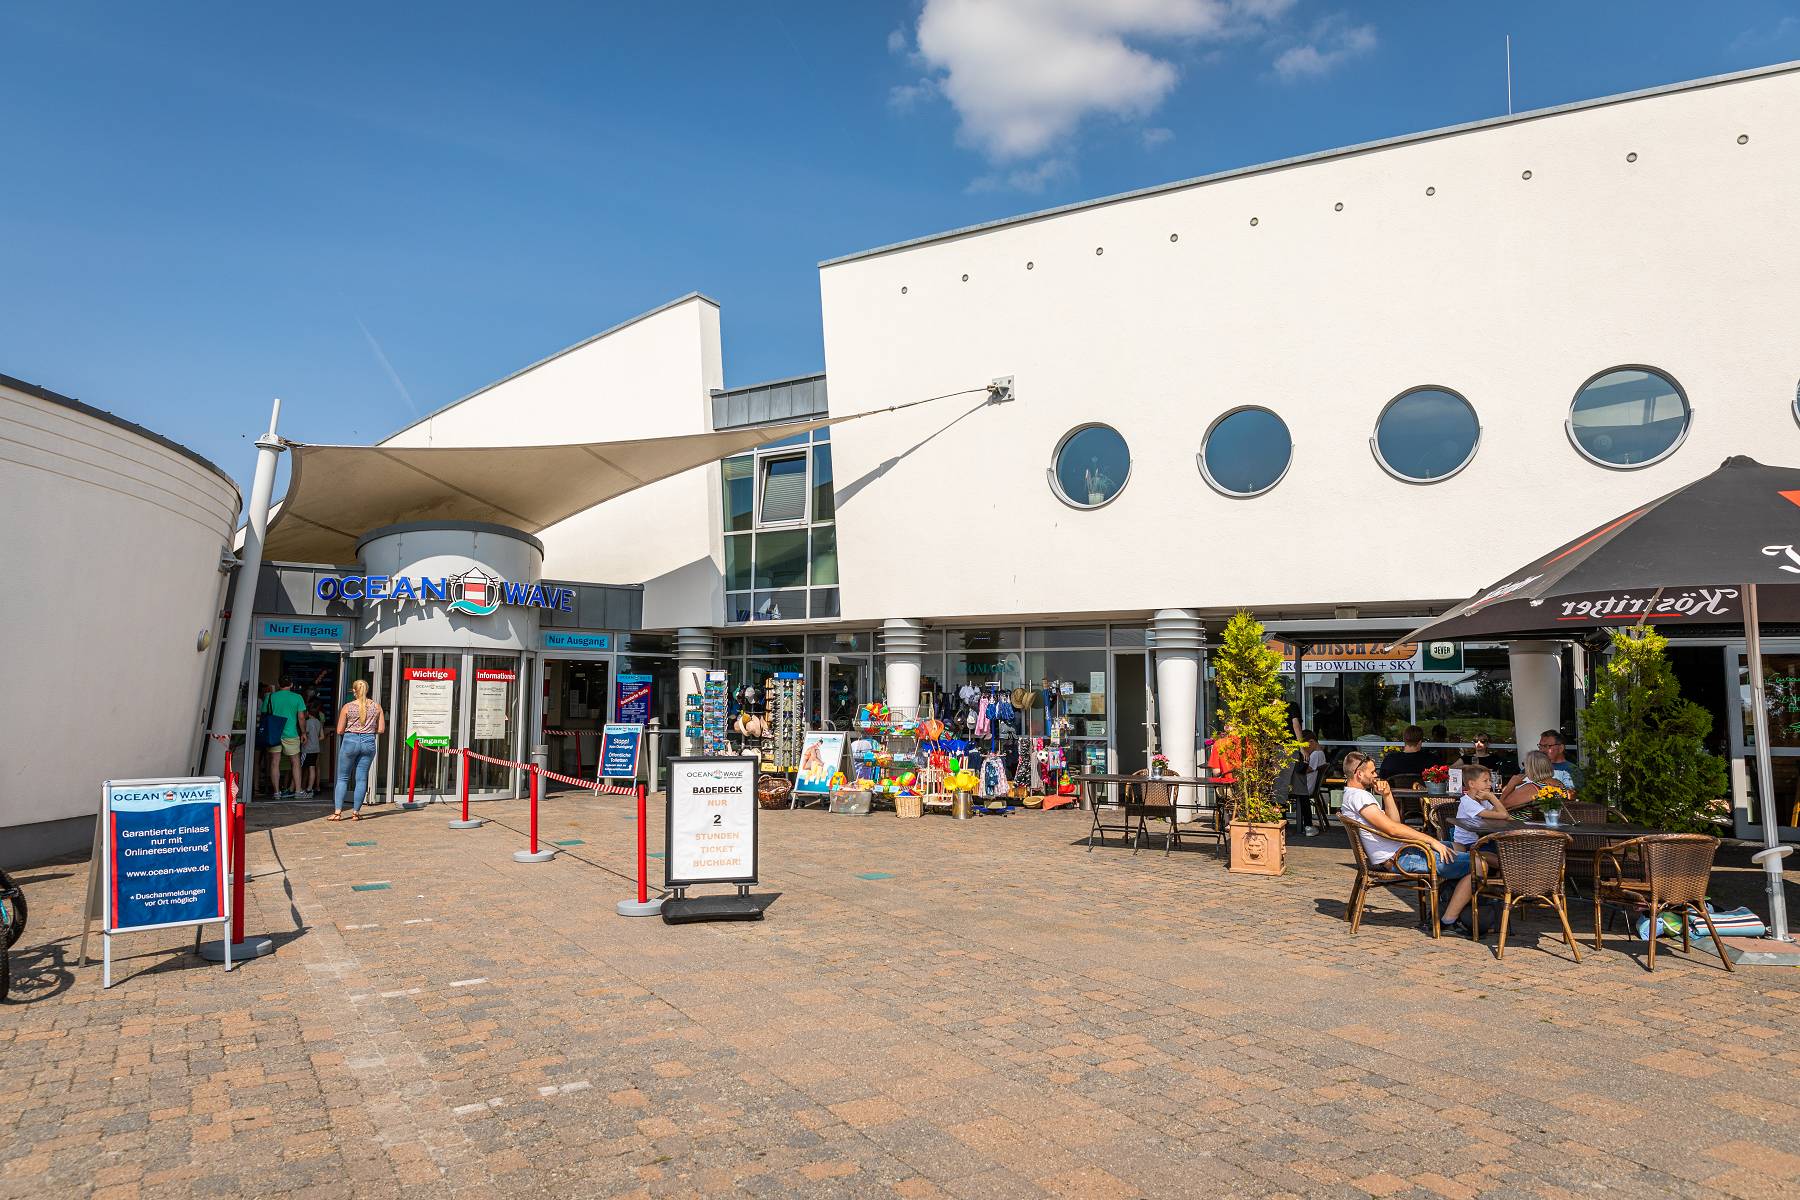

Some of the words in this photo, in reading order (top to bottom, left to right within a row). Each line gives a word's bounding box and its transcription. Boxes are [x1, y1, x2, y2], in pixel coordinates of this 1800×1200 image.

[316, 575, 447, 600] OCEAN
[504, 581, 574, 613] WAVE
[269, 623, 289, 634] Nur
[293, 624, 338, 637] Eingang
[548, 635, 564, 644] Nur
[567, 636, 605, 647] Ausgang
[1434, 646, 1451, 655] JEVER
[1316, 661, 1375, 671] BOWLING
[1390, 660, 1416, 671] SKY
[412, 671, 449, 679] Wichtige
[477, 671, 515, 680] Informationen
[613, 737, 630, 745] Stopp!
[692, 786, 743, 794] BADEDECK
[113, 792, 160, 801] OCEAN
[180, 790, 213, 799] WAVE
[707, 799, 728, 807] NUR
[713, 814, 722, 824] 2
[122, 827, 176, 838] Garantierter
[178, 825, 210, 835] Einlass
[168, 836, 183, 845] mit
[695, 832, 740, 841] STUNDEN
[700, 845, 736, 854] TICKET
[693, 858, 741, 867] BUCHBAR!
[126, 864, 210, 878] www.ocean-wave.de
[157, 898, 169, 906] Ort
[170, 896, 198, 905] möglich
